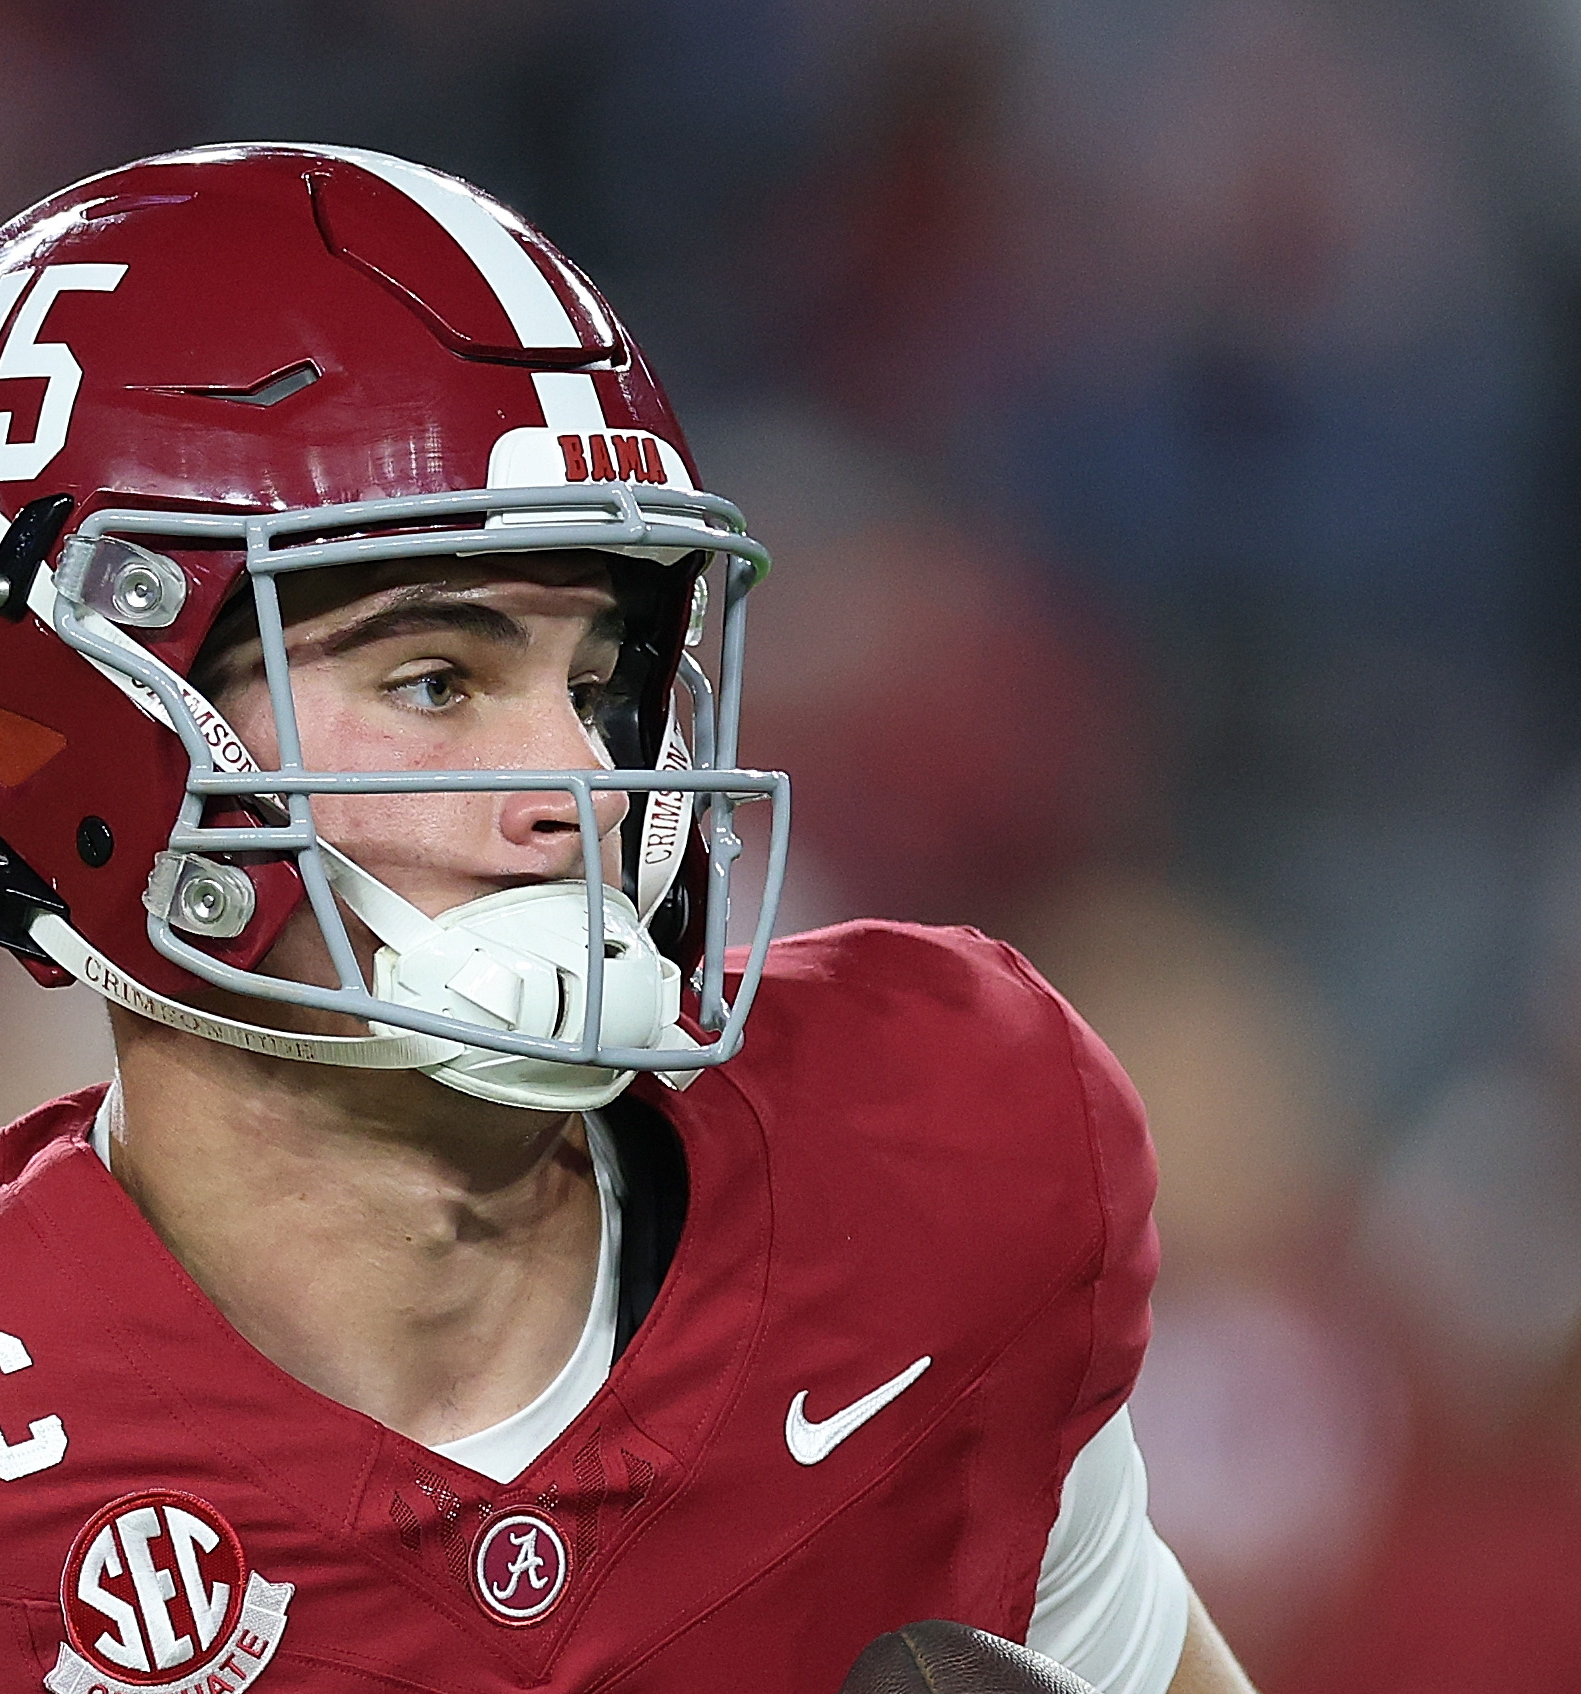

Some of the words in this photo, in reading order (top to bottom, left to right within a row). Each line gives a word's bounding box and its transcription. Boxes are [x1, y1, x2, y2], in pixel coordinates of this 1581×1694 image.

[557, 434, 668, 484] BAMA
[77, 1505, 231, 1673] SEC
[492, 1527, 549, 1600] A
